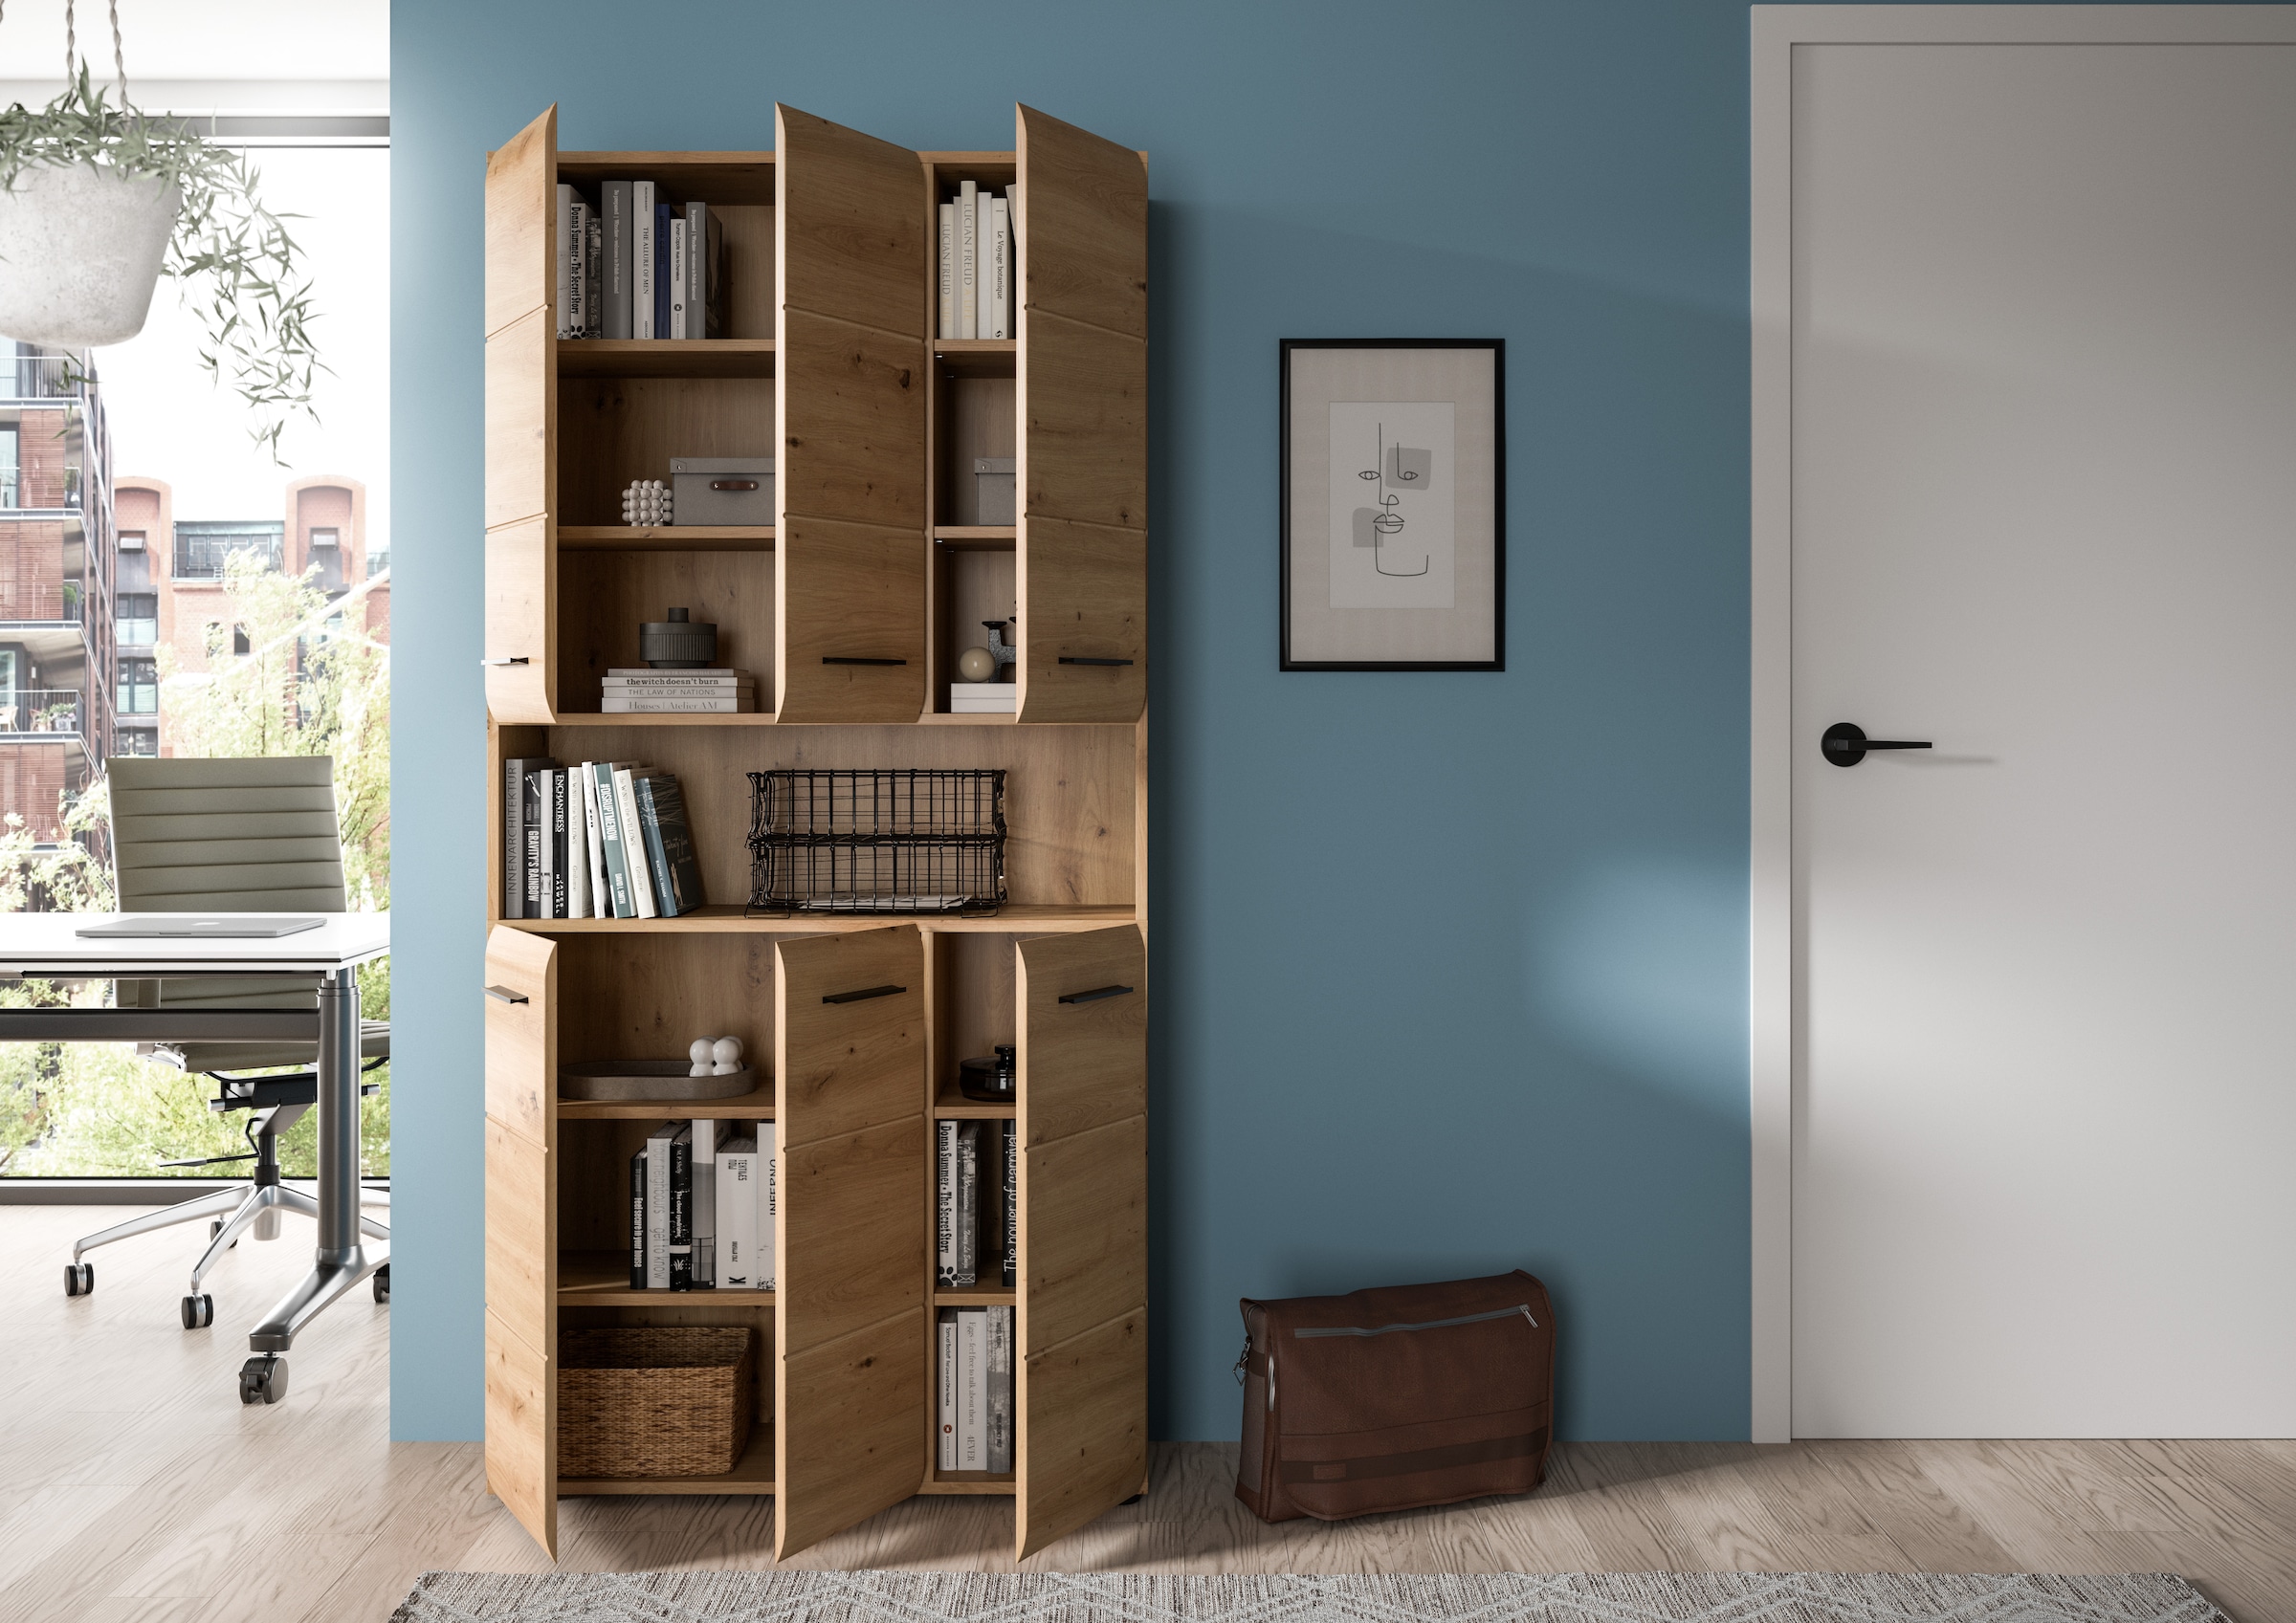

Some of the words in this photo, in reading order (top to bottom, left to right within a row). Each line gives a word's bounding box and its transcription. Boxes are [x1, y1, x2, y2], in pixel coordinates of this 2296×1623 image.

[571, 207, 581, 229] Donna
[963, 204, 973, 245] LUCIAN
[571, 230, 581, 257] Summer
[941, 224, 951, 260] LUCIAN
[995, 241, 1004, 265] Voyage
[571, 263, 581, 275] The
[643, 269, 650, 278] OF
[963, 250, 973, 286] FREUD
[571, 276, 581, 297] Secret
[941, 264, 951, 295] FREUD
[995, 266, 1004, 299] botanique
[570, 297, 581, 315] Story
[963, 300, 972, 319] LIFE
[629, 701, 661, 710] Houses
[669, 701, 698, 710] Atelier
[600, 783, 618, 841] #DISRUPTMENOW
[507, 767, 518, 895] INNENARCHITEKTUR
[627, 818, 636, 846] WILLOWS
[528, 830, 540, 866] GRAVITY'S
[528, 868, 540, 902] RAINBOW
[615, 873, 624, 888] DAVID
[616, 890, 627, 904] SMITH
[940, 1126, 952, 1151] Donna
[653, 1143, 669, 1162] Your
[1004, 1134, 1016, 1184] carnival
[738, 1159, 748, 1181] TEXTILES
[940, 1152, 952, 1186] Summer
[650, 1165, 669, 1214] neighbours
[940, 1192, 952, 1207] The
[1004, 1185, 1016, 1201] of
[633, 1197, 643, 1210] Feel
[633, 1210, 643, 1230] secure
[940, 1208, 952, 1231] Secret
[632, 1237, 643, 1249] your
[650, 1227, 668, 1241] get
[939, 1233, 952, 1254] Story
[633, 1250, 643, 1267] house
[653, 1244, 667, 1254] to
[653, 1257, 668, 1280] know
[1004, 1248, 1016, 1273] The
[966, 1322, 977, 1338] Eggs
[968, 1343, 977, 1354] feel
[968, 1356, 977, 1369] free
[968, 1376, 977, 1390] talk
[968, 1390, 977, 1408] about
[968, 1409, 977, 1425] them
[966, 1435, 976, 1462] 4EVER
